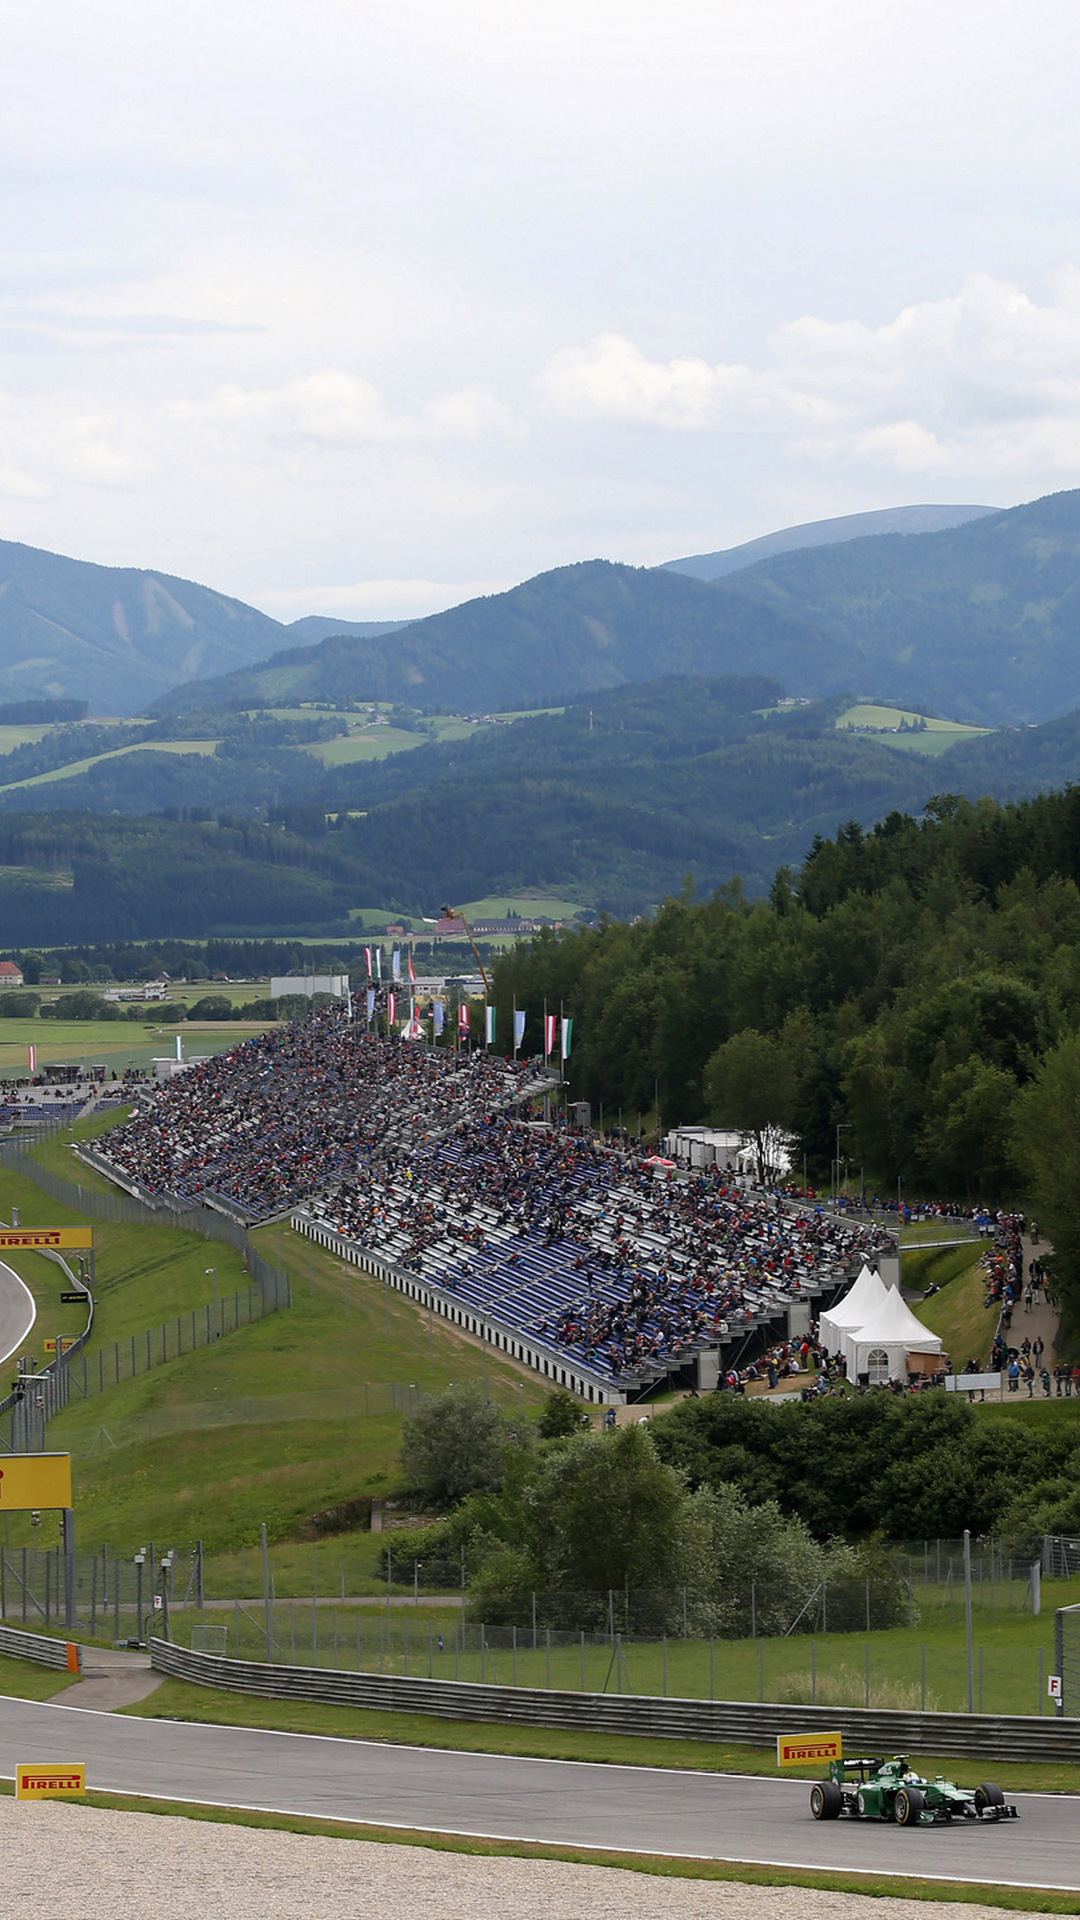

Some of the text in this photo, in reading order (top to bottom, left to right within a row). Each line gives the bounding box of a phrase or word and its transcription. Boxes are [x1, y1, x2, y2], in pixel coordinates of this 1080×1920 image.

[1051, 1680, 1058, 1692] F
[784, 1743, 837, 1760] PIRELLI
[22, 1775, 81, 1789] PIRELLI
